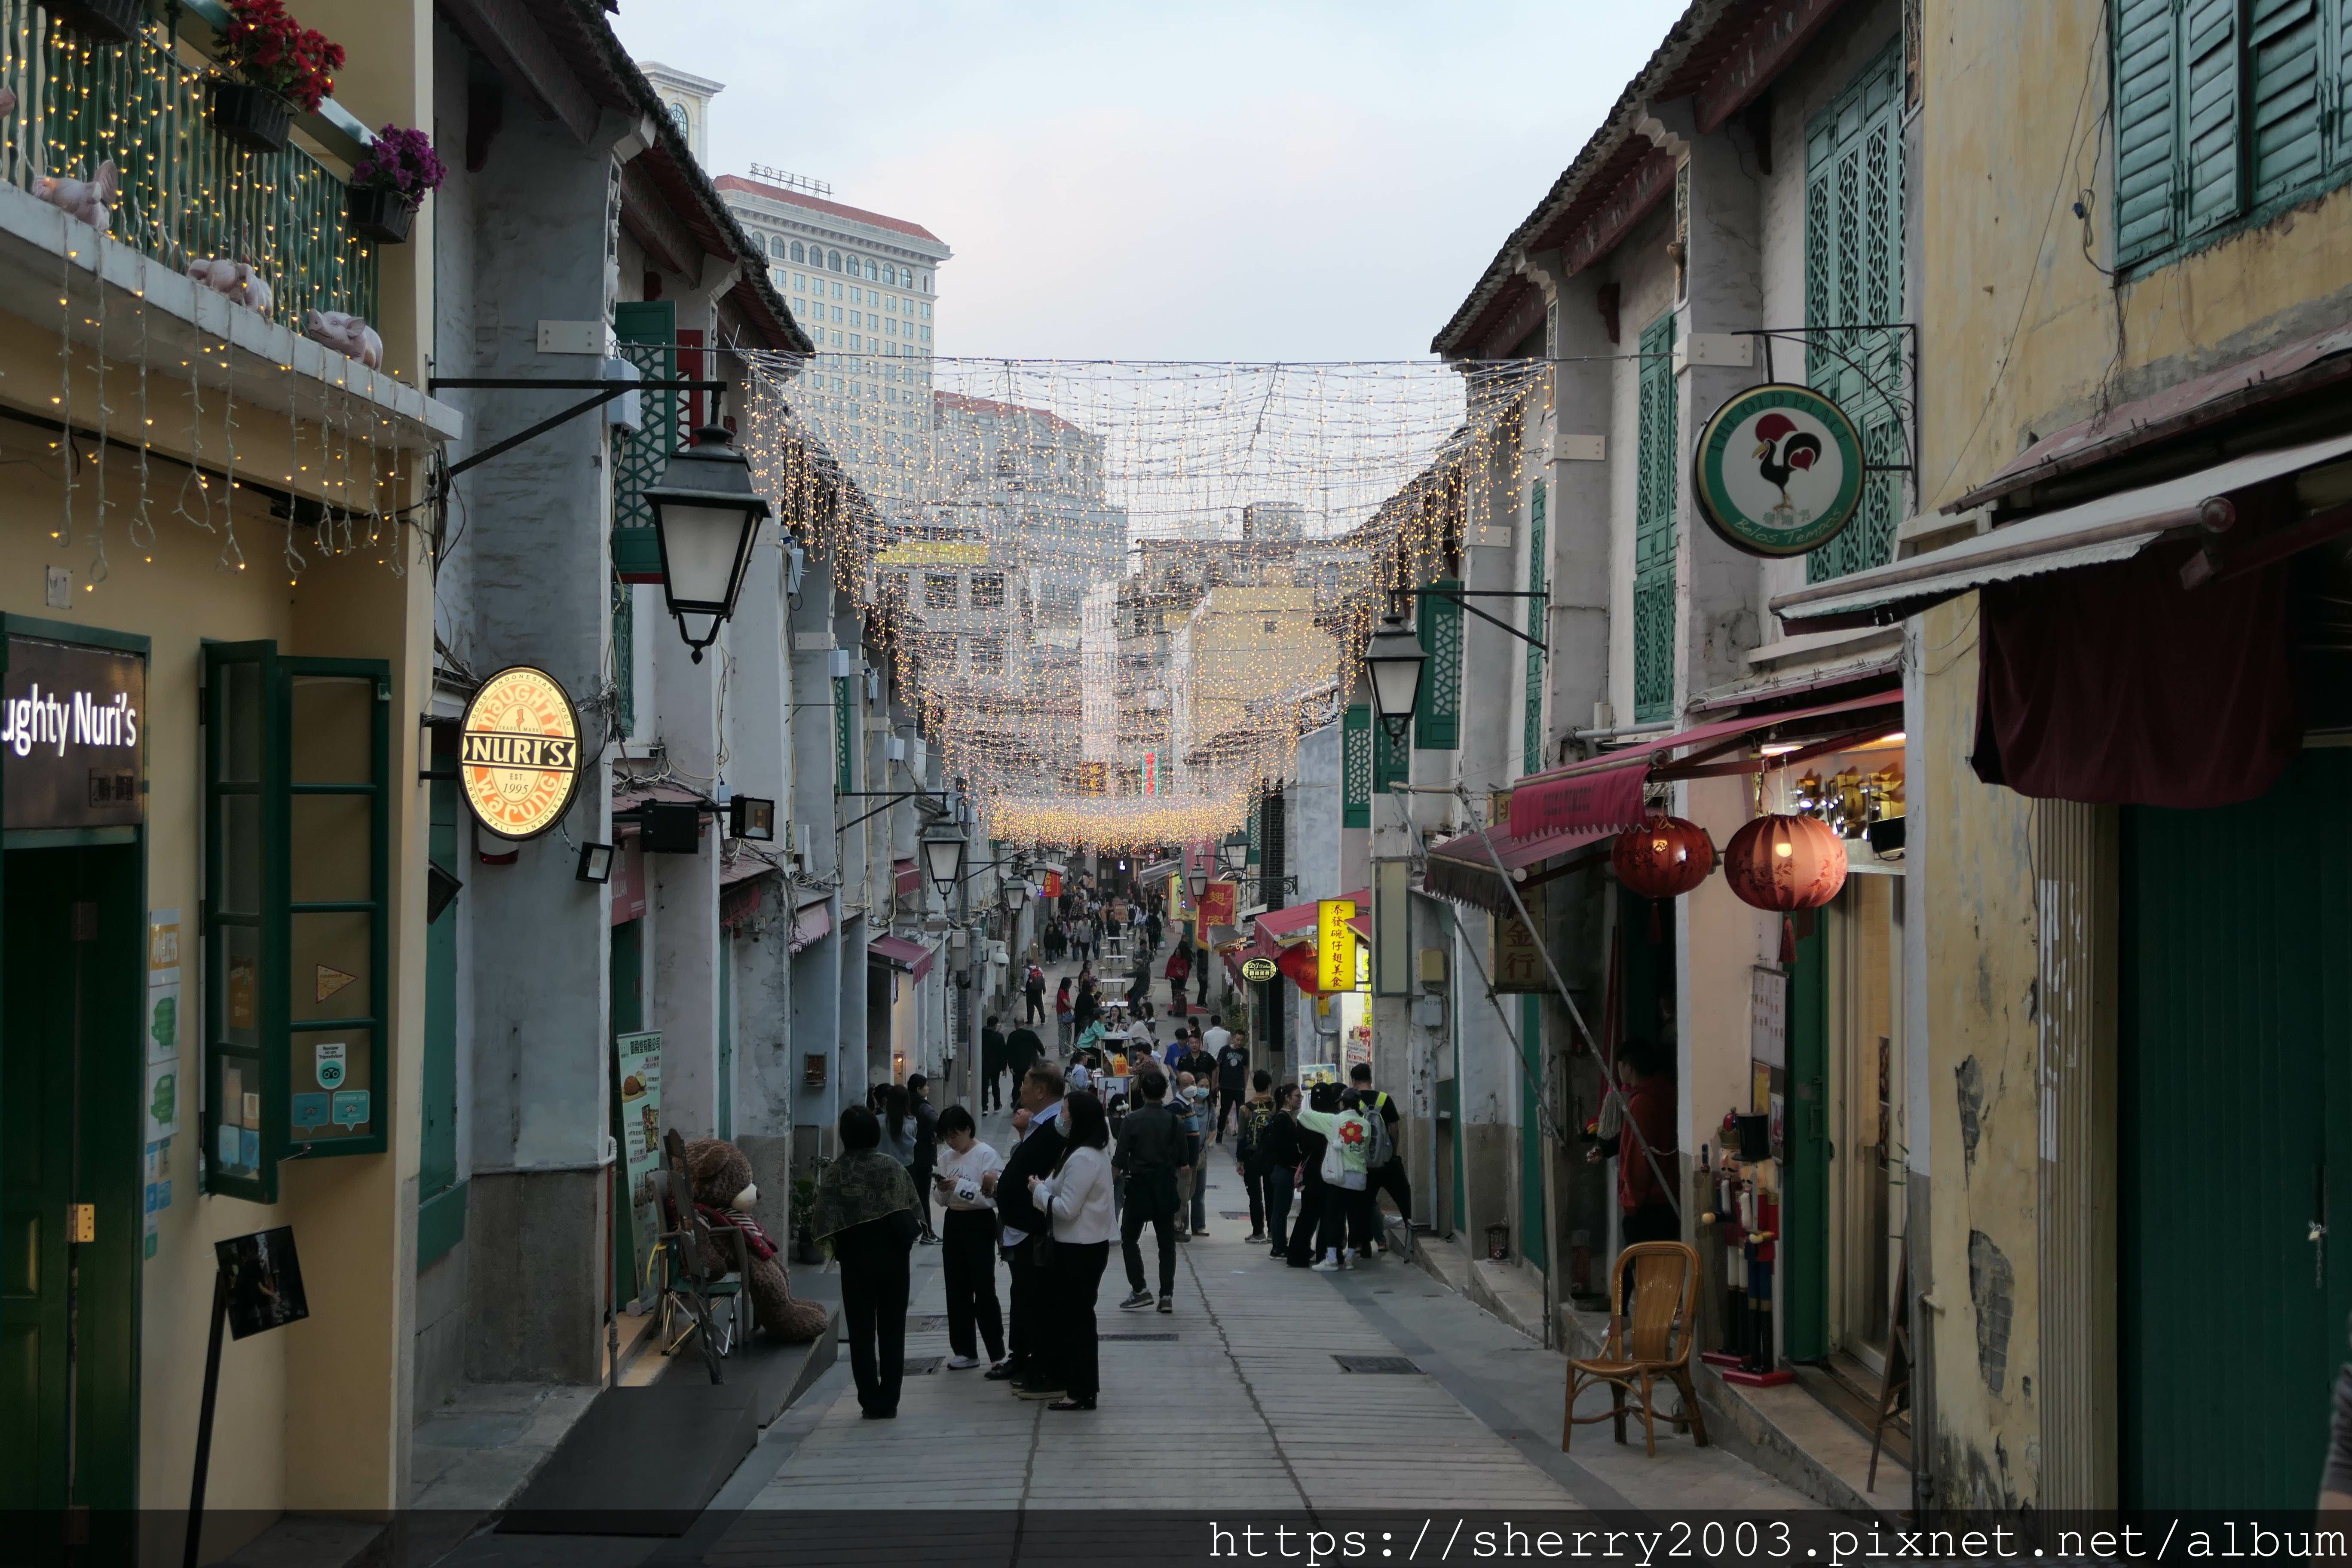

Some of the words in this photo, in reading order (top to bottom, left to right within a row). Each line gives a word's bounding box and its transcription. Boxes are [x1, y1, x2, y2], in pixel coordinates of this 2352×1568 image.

[1709, 413, 1740, 453] THE
[1741, 393, 1784, 415] OLD
[1792, 393, 1852, 446] PLACE
[1734, 517, 1779, 544] Belos
[74, 691, 136, 747] Nuri's
[471, 695, 487, 719] GOOD
[494, 674, 552, 692] INDONESIAN
[559, 701, 571, 726] FOOD
[472, 736, 564, 766] NURI'S
[467, 780, 479, 806] UBUD
[488, 818, 509, 832] BALI
[526, 786, 567, 832] INDONESIA
[502, 783, 529, 794] 1995
